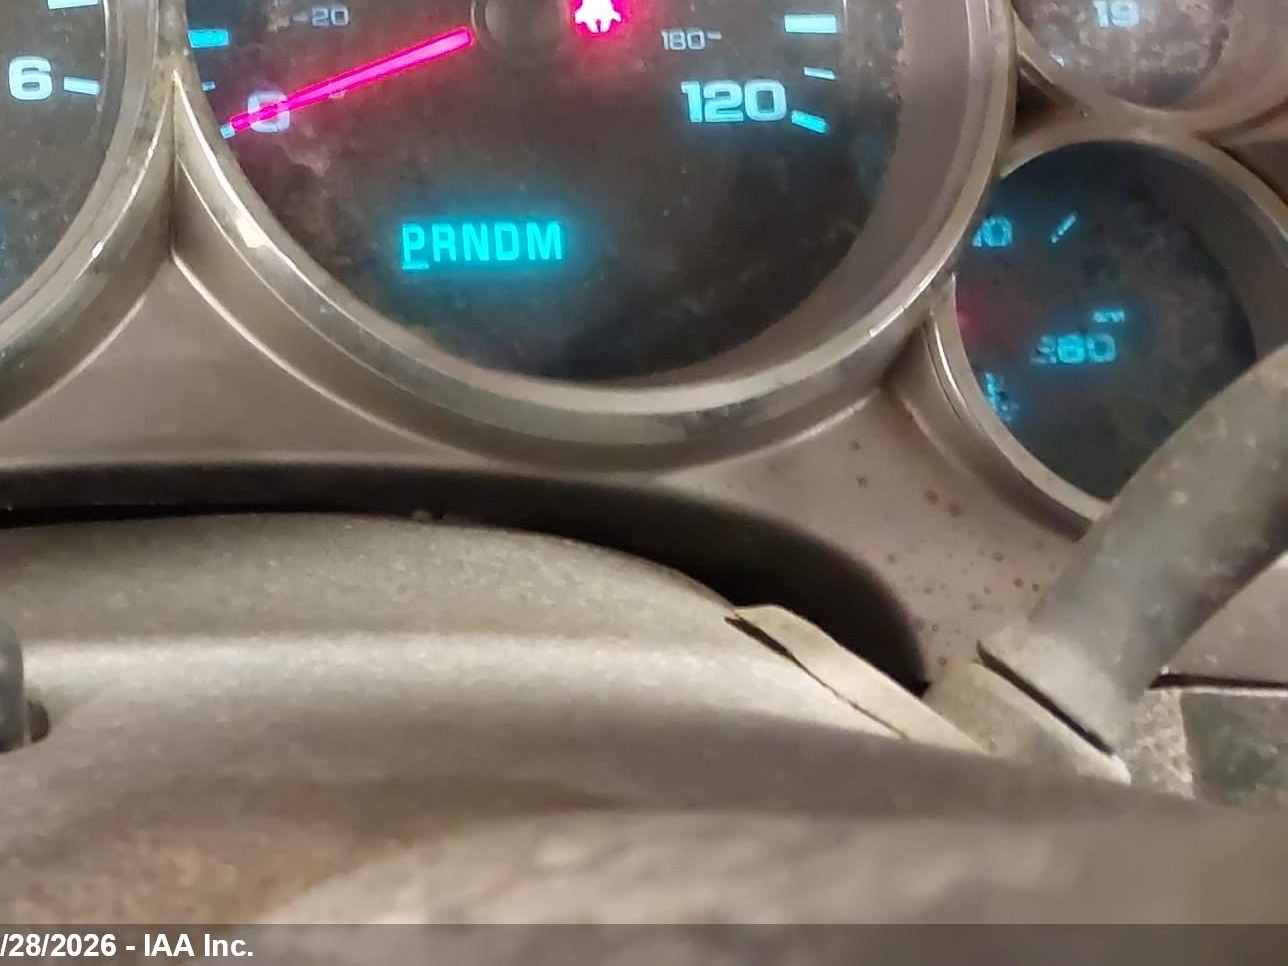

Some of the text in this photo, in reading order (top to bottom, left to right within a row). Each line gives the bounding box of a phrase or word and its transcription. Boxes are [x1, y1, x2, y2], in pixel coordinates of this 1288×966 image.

[311, 4, 350, 27] 20
[661, 27, 707, 51] 180
[7, 55, 53, 102] 6
[246, 90, 291, 133] 0
[681, 78, 787, 124] 120
[402, 222, 563, 269] PRNDM
